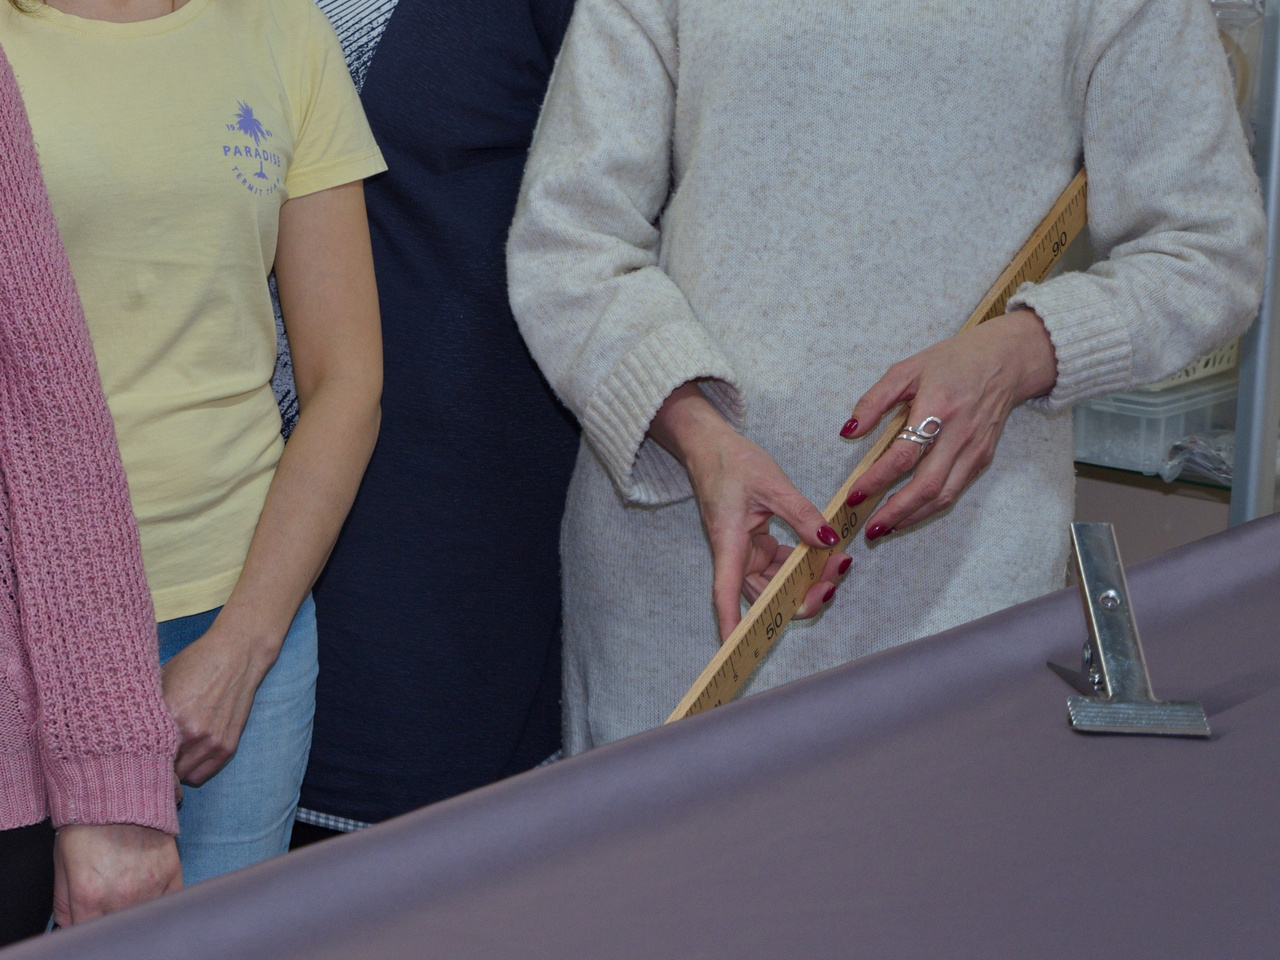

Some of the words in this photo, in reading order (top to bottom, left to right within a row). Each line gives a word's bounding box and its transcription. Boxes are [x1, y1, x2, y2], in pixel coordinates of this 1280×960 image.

[225, 123, 236, 131] 19
[222, 145, 281, 168] PARADISE
[231, 165, 263, 197] TERMIT
[765, 612, 784, 641] 50
[841, 511, 858, 540] 60
[1052, 230, 1068, 258] 90
